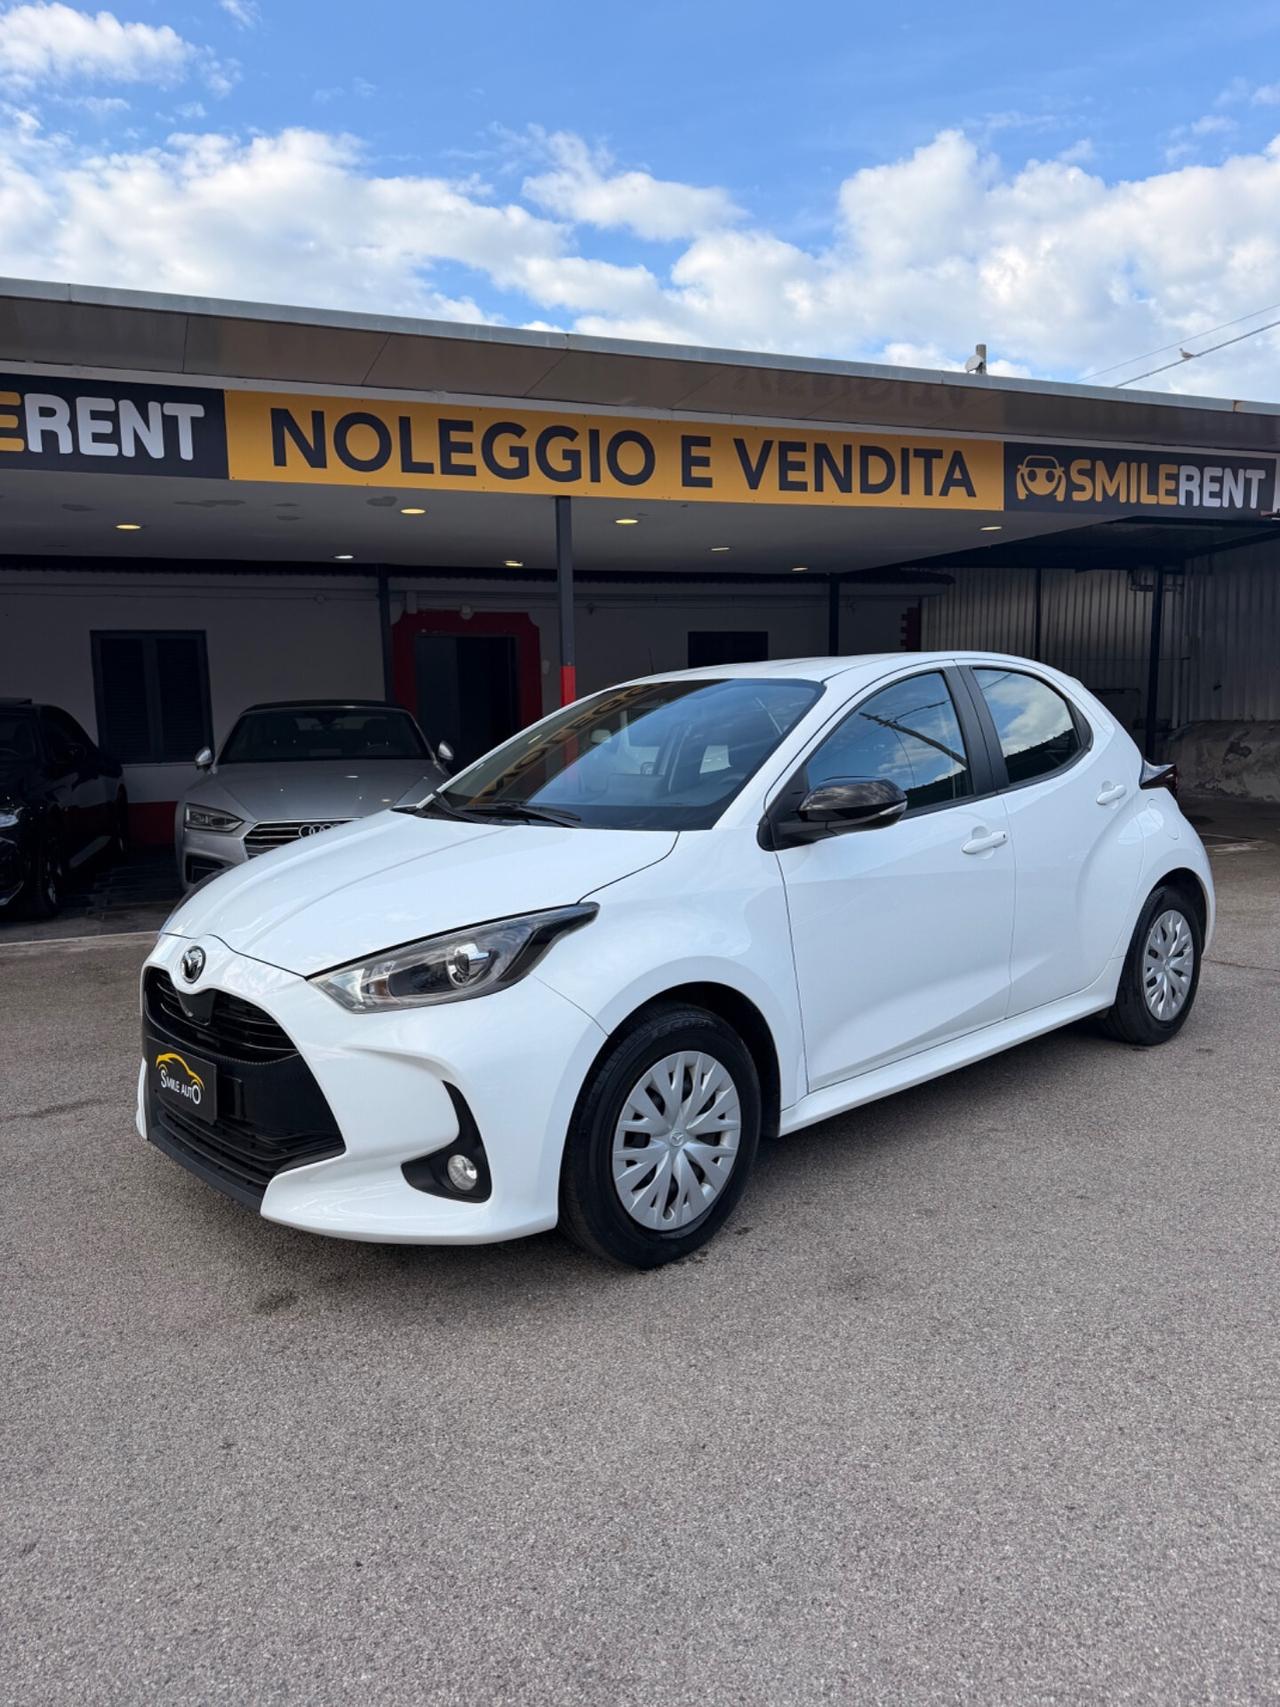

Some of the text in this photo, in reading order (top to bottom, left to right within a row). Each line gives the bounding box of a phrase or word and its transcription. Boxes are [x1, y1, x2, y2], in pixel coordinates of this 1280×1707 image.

[269, 407, 977, 498] NOLEGGIO E VENDITA
[1070, 459, 1266, 509] SMILERENT
